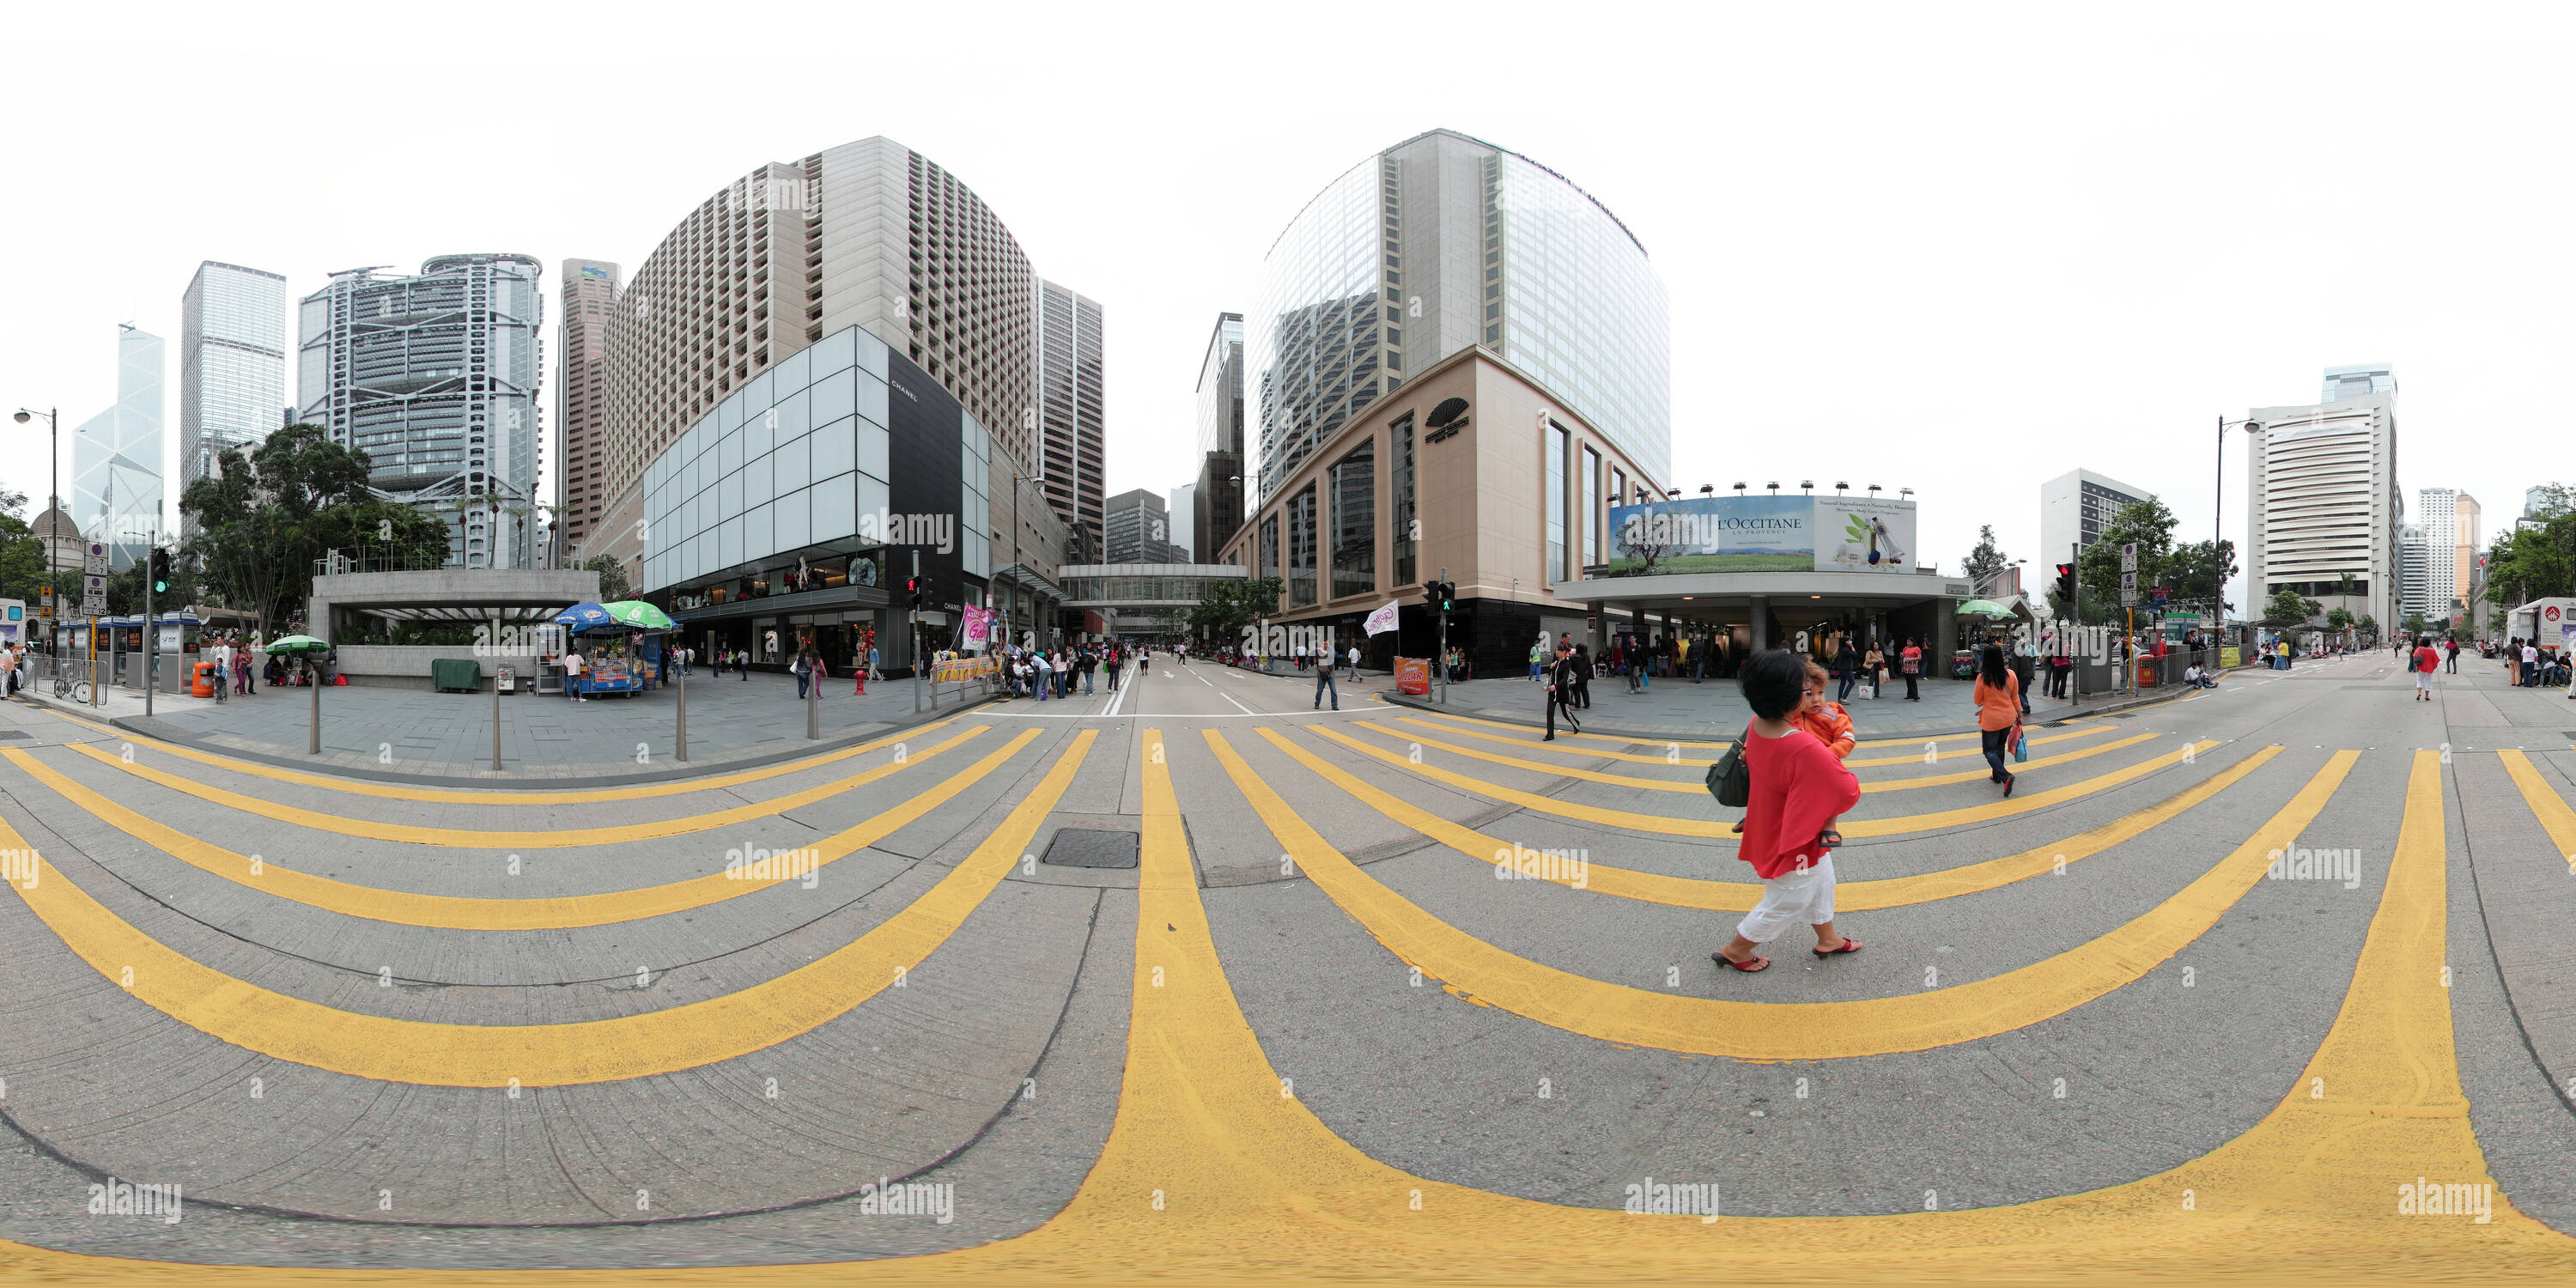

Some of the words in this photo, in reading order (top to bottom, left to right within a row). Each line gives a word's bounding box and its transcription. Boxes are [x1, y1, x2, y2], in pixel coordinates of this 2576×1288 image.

[891, 380, 918, 403] CHANEL
[1718, 517, 1801, 531] L'OCCITANE
[944, 602, 962, 612] CHANEL
